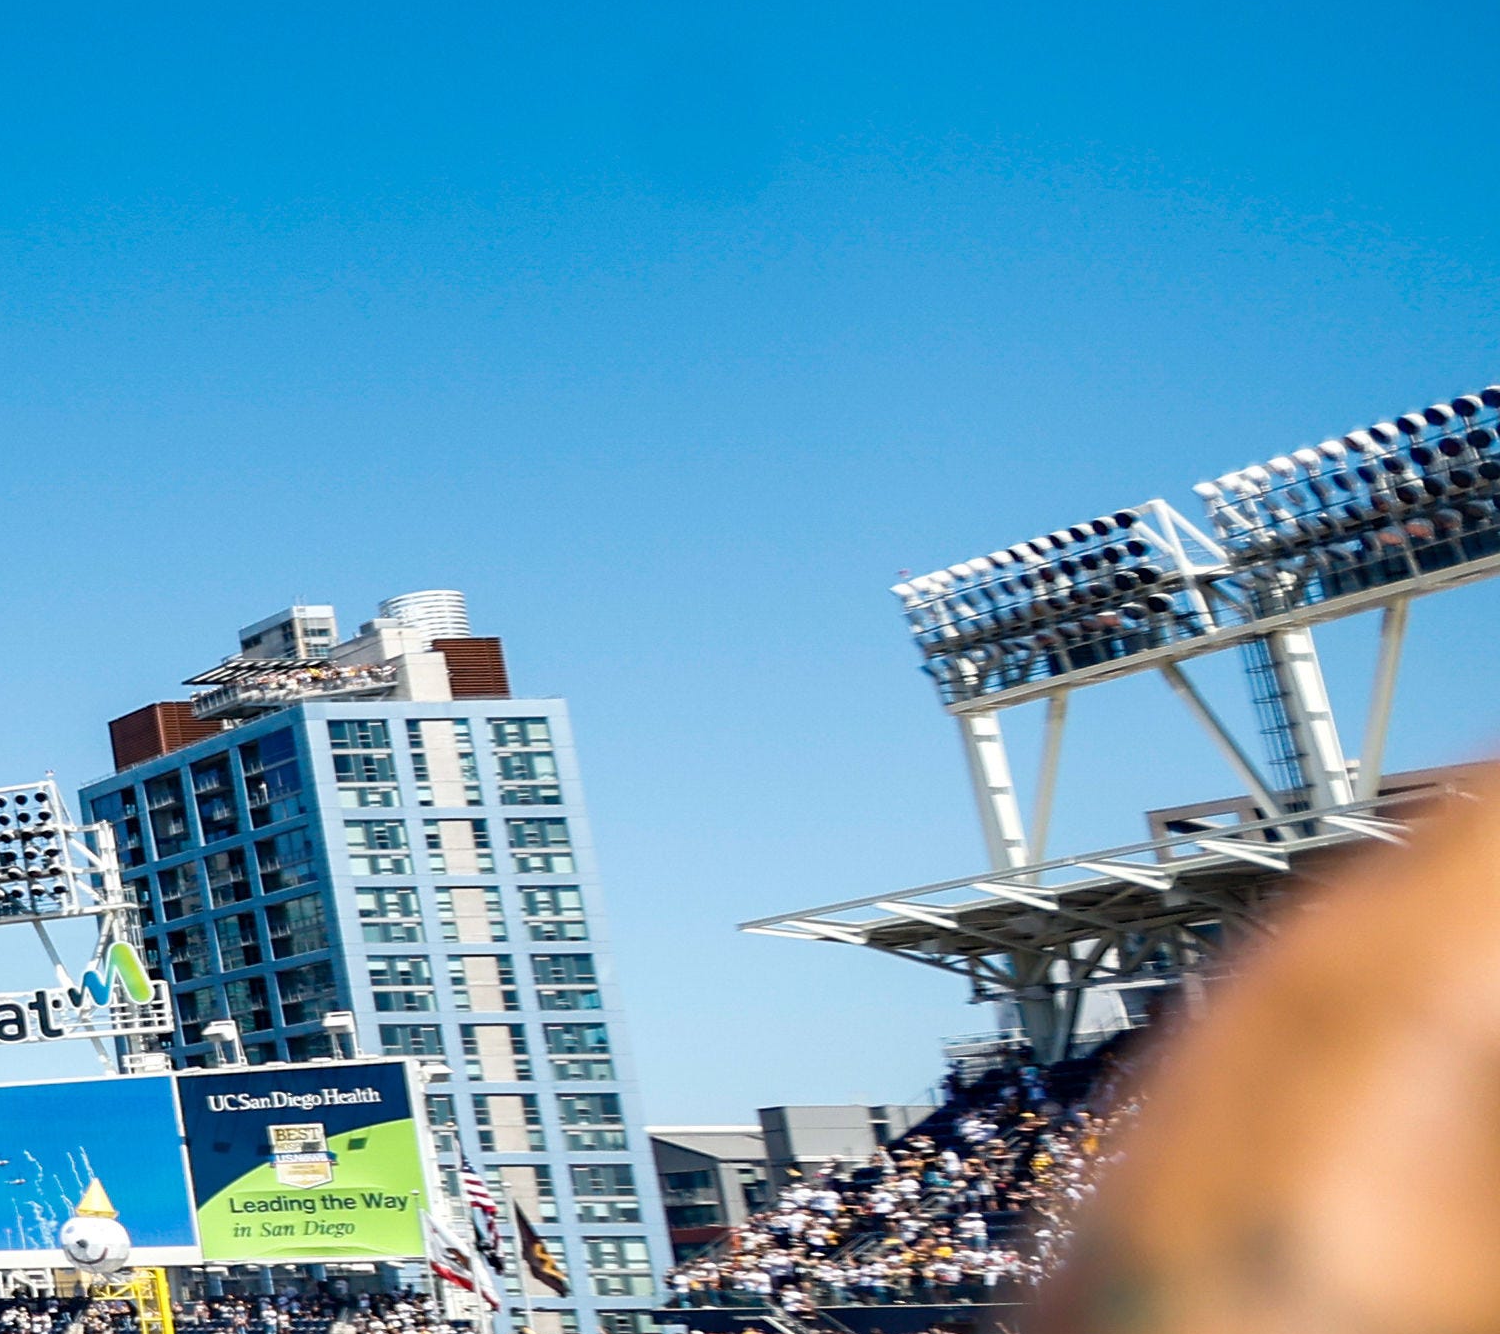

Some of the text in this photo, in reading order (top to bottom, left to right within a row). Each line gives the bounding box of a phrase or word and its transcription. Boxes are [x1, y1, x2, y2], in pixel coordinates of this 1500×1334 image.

[208, 1087, 382, 1111] UC San Diego Health
[275, 1128, 319, 1141] BEST
[230, 1193, 409, 1214] Leading the Way
[233, 1220, 356, 1239] in San Diego
